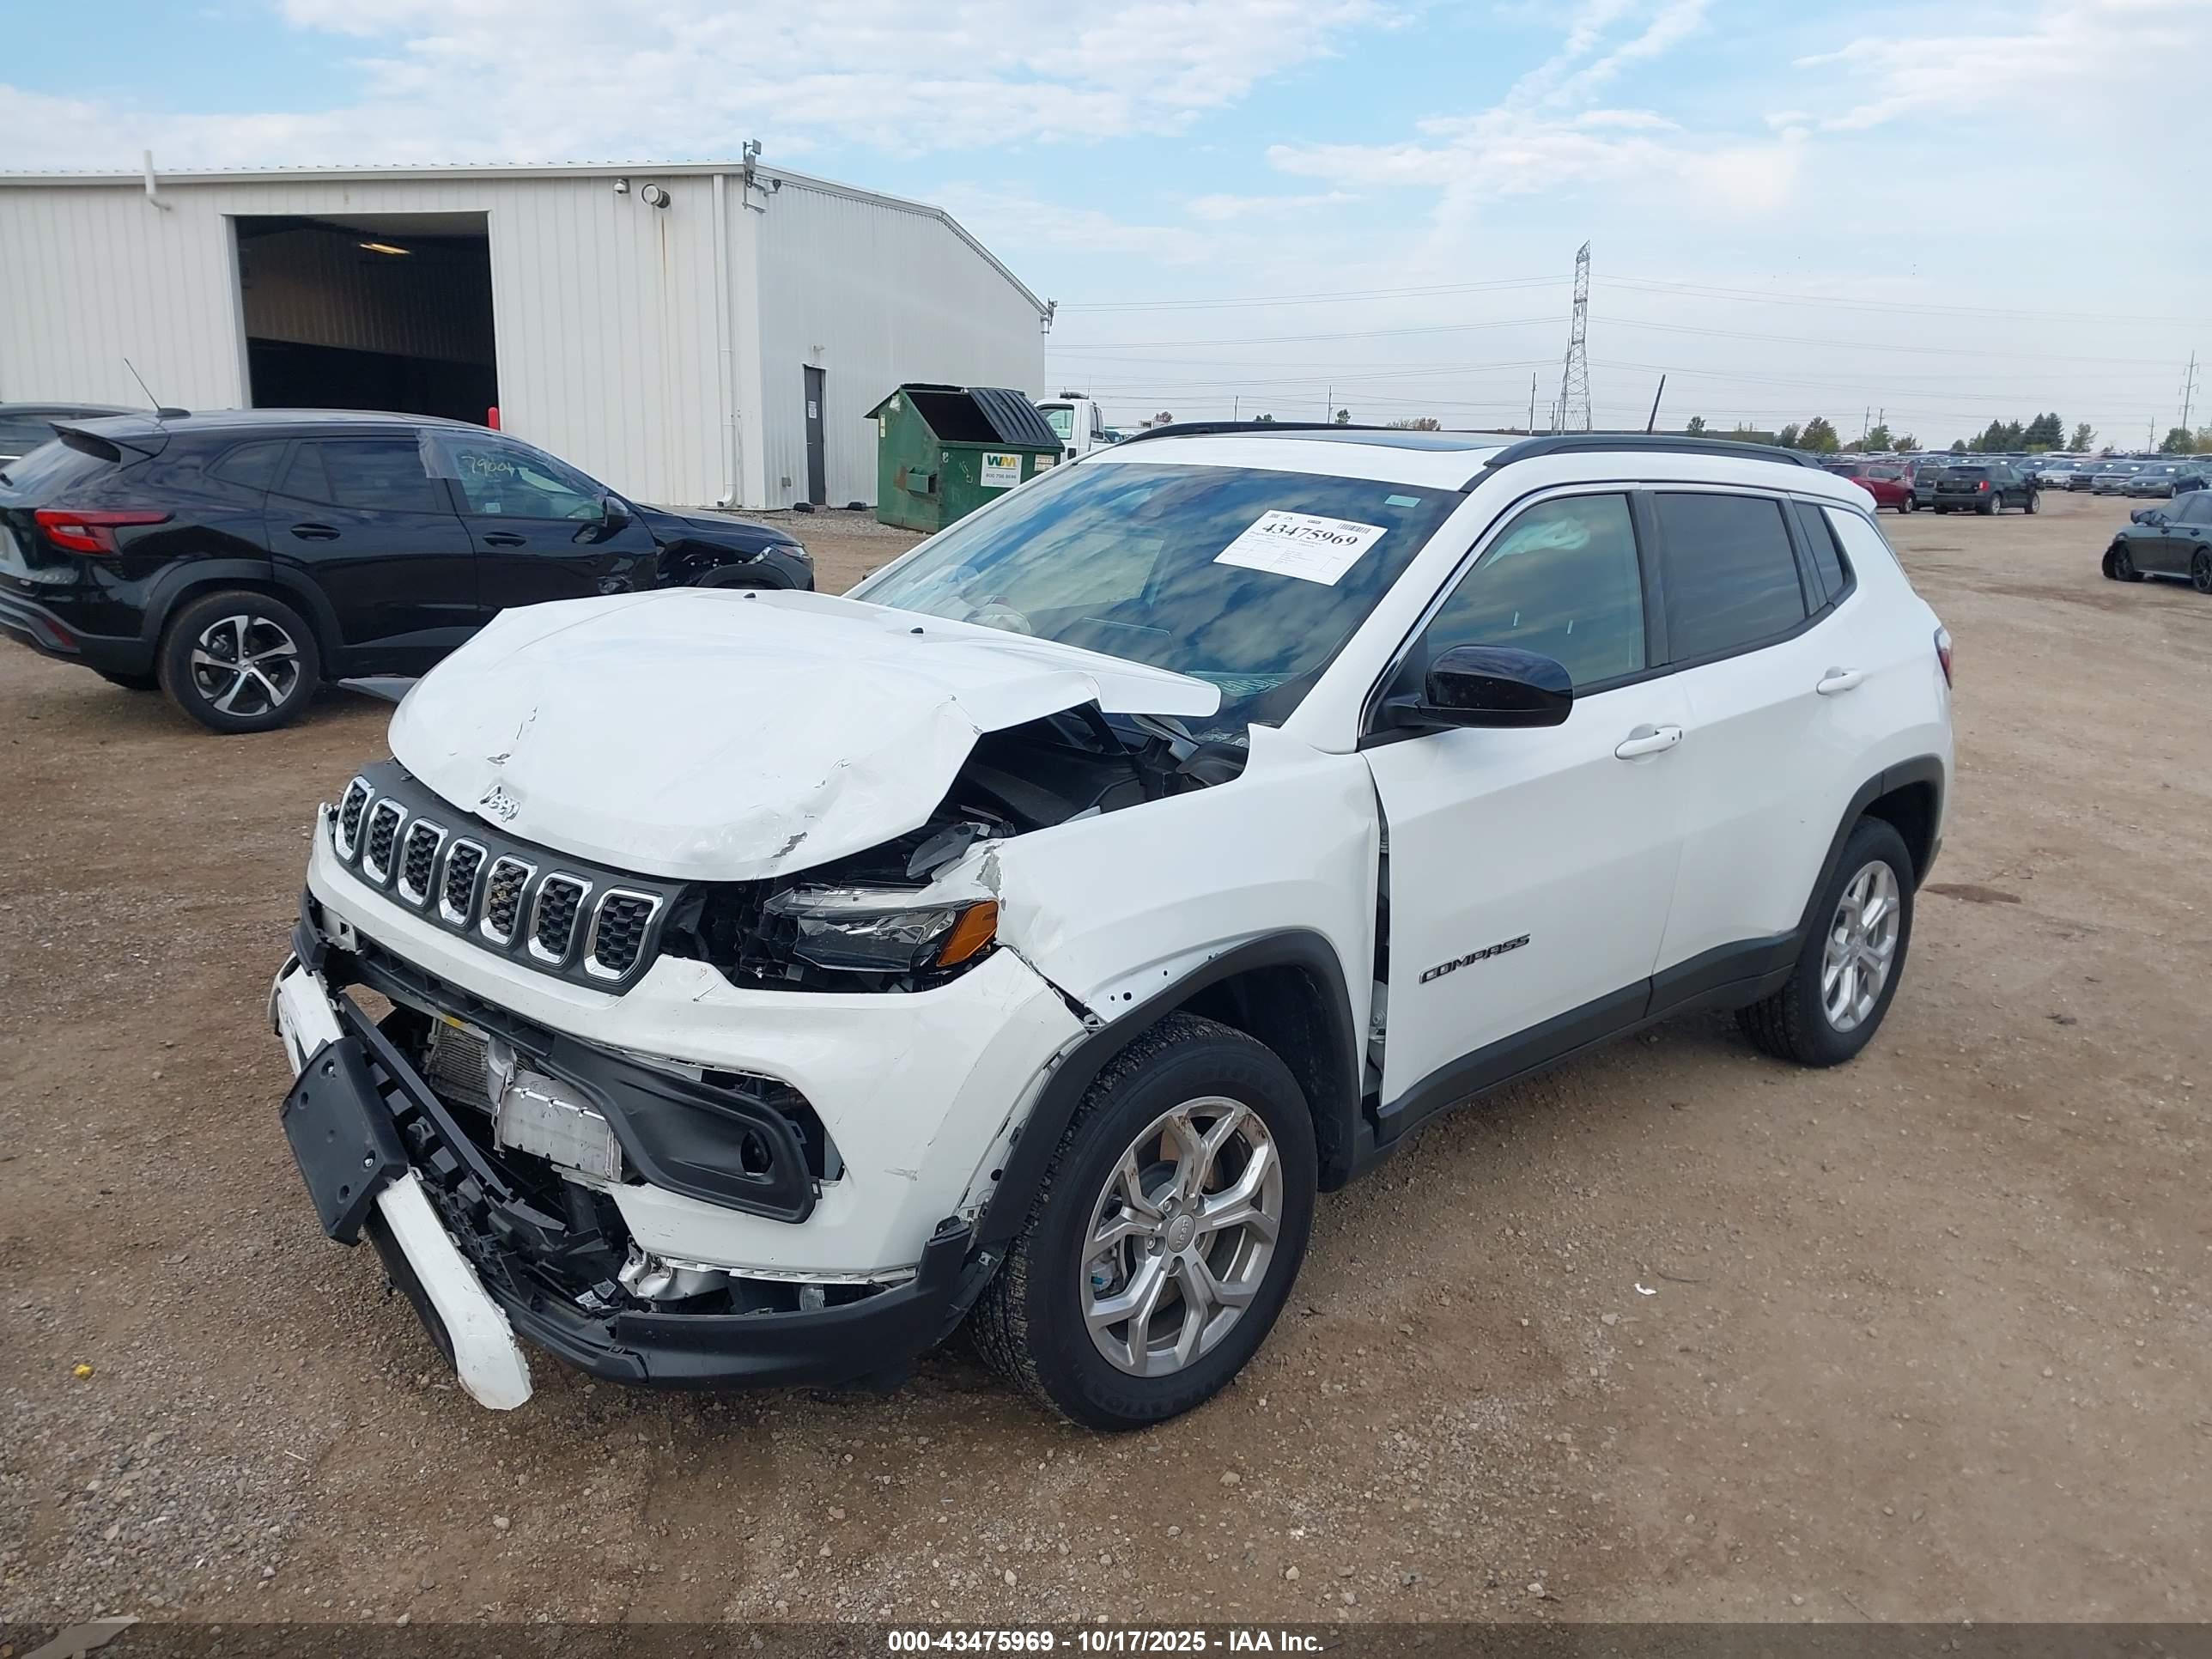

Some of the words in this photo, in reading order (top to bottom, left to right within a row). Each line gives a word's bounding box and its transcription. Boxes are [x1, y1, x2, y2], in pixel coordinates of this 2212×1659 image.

[987, 454, 1018, 468] WM
[1262, 523, 1358, 546] 43475969
[480, 784, 521, 823] Jeep
[1419, 933, 1530, 984] COMPASS
